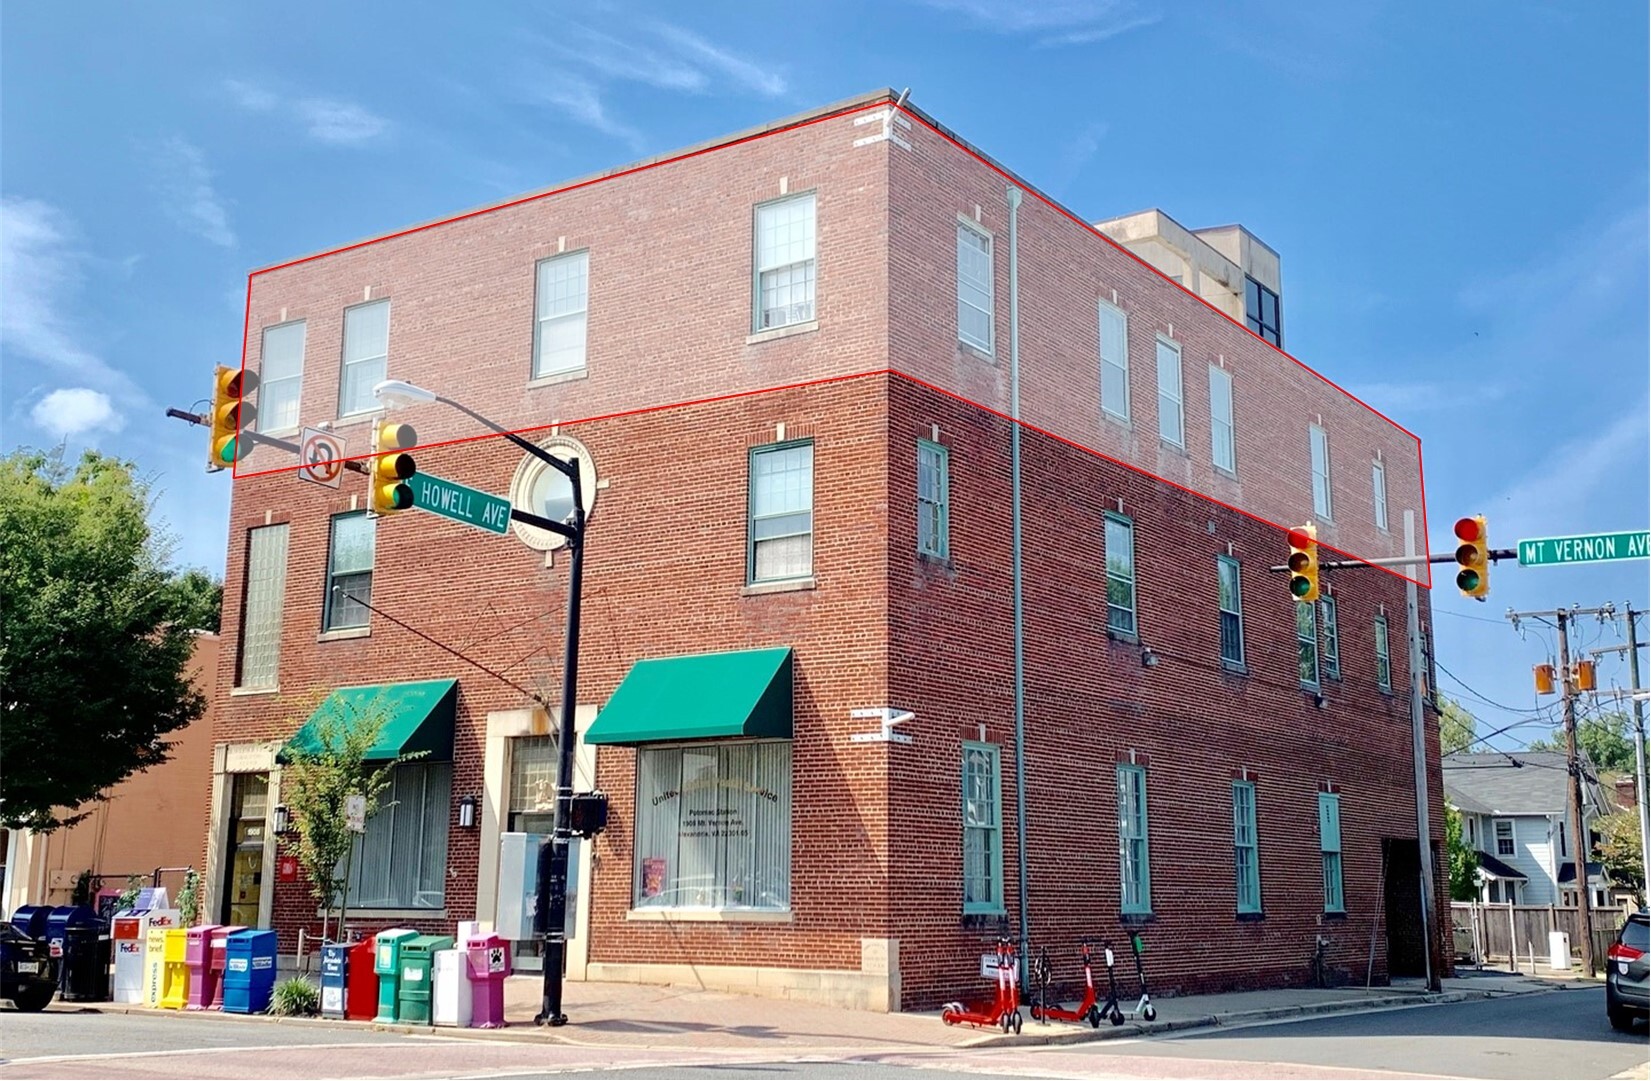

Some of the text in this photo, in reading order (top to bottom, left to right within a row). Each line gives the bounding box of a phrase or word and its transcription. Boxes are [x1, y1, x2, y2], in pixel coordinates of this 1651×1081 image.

[421, 481, 507, 528] HOWELL AVE
[1525, 542, 1545, 563] MT
[1553, 537, 1616, 561] VERNON
[149, 917, 172, 926] FedEx
[120, 943, 139, 952] FedEx
